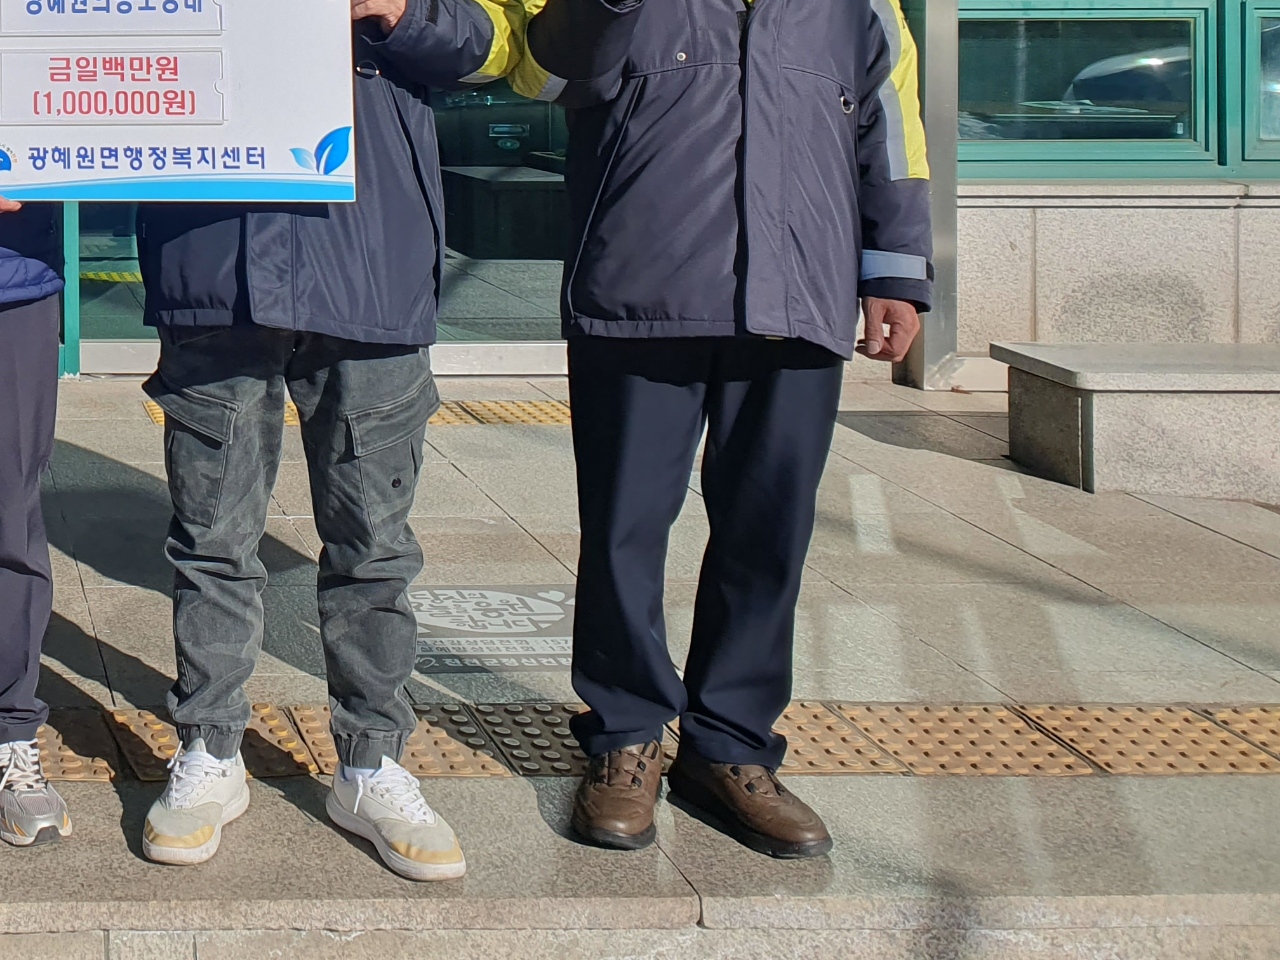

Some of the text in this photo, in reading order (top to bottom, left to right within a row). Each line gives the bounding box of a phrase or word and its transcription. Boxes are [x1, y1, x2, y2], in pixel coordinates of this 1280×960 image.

[47, 56, 180, 82] 금일백만원
[32, 90, 196, 116] (1,000,000원)
[27, 145, 266, 171] 광혜원면행정복지센터
[449, 614, 552, 630] 합니다
